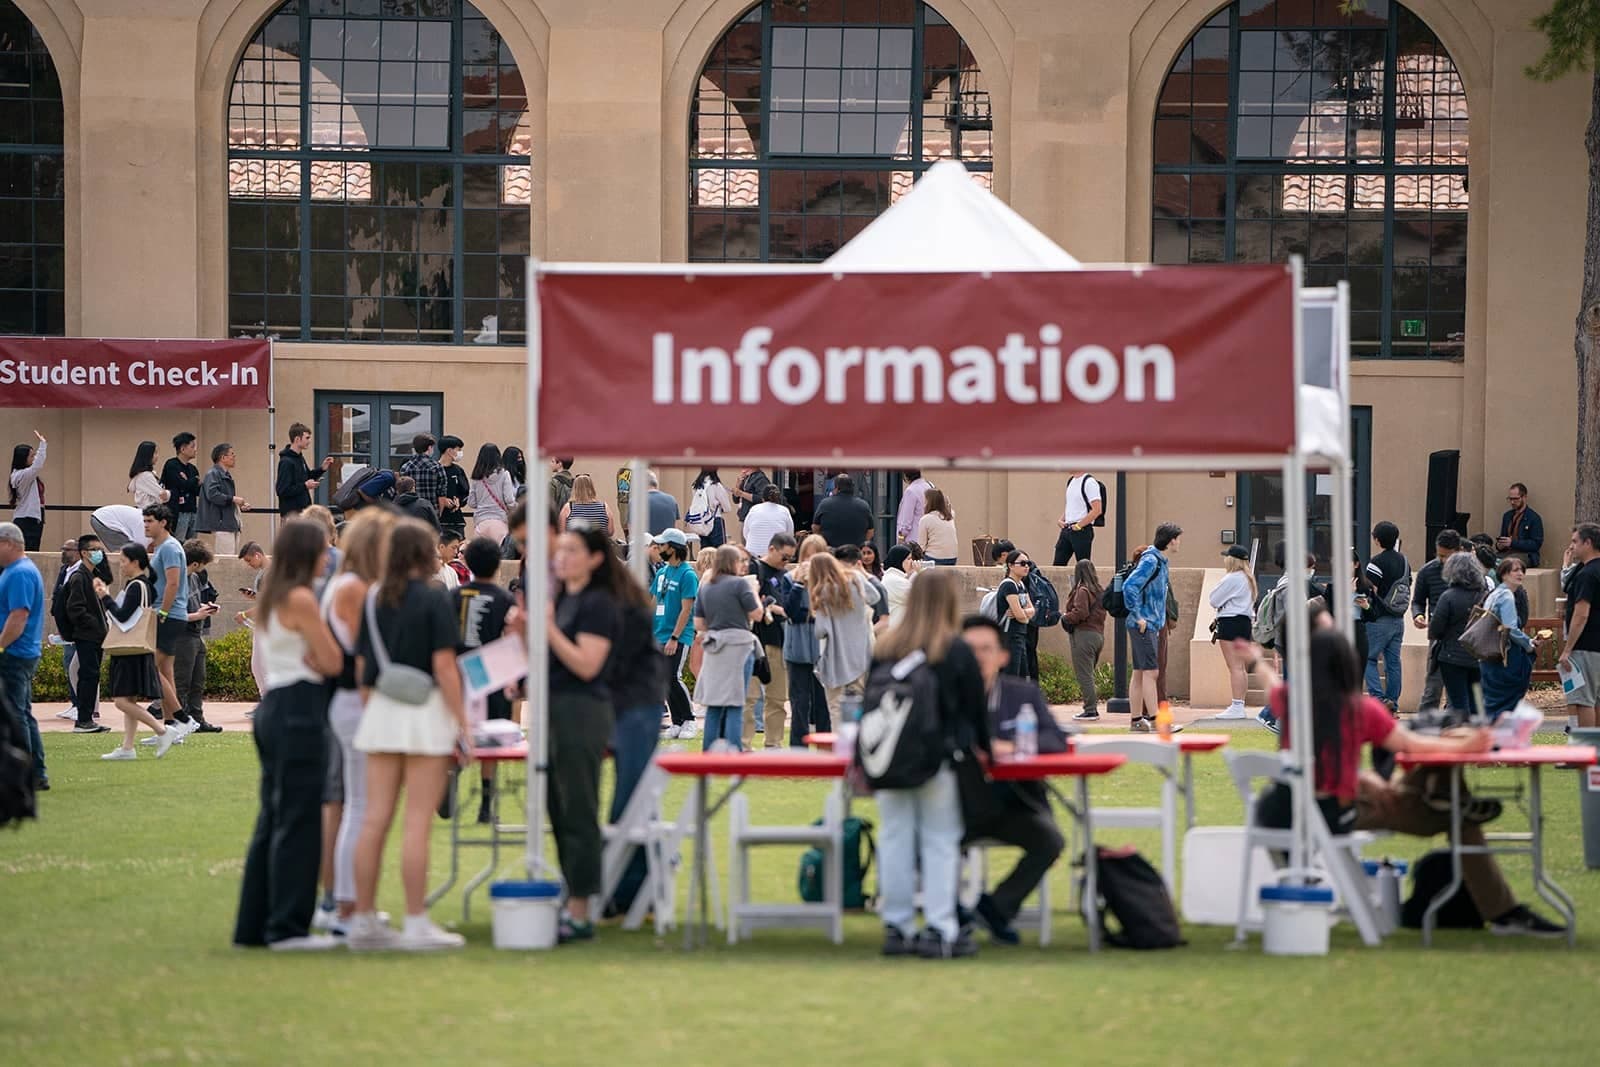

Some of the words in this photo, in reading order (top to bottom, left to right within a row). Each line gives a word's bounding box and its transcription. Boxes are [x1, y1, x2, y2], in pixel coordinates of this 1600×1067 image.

[0, 359, 121, 386] Student
[128, 360, 259, 386] Check-In
[652, 323, 1176, 405] Information
